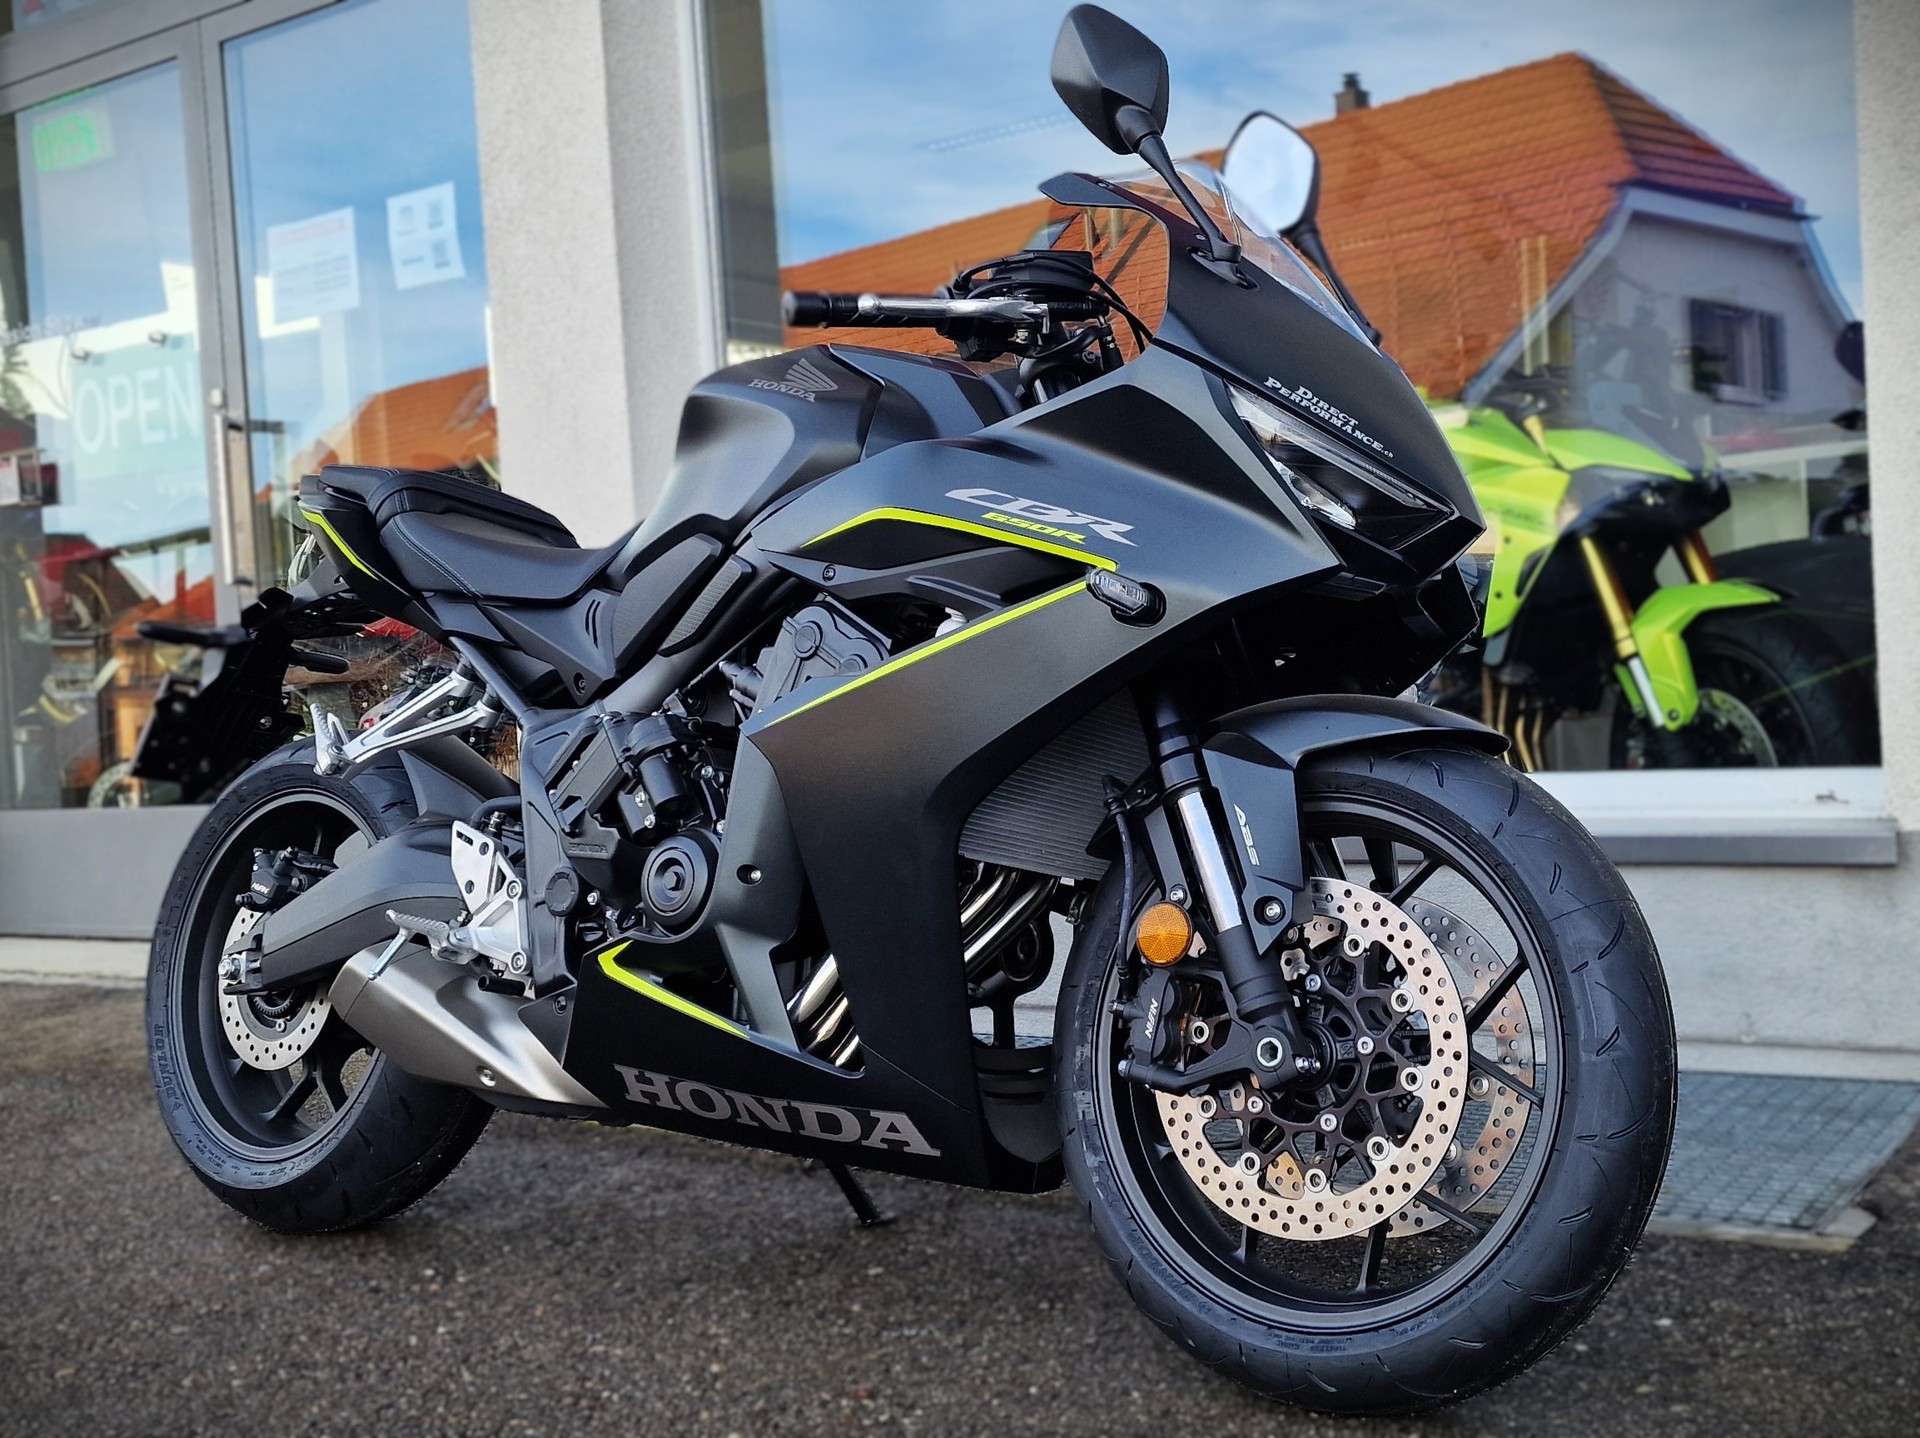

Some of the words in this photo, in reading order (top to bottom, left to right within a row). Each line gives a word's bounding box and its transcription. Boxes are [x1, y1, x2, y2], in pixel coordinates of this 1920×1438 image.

[73, 362, 202, 454] OPEN
[748, 379, 816, 402] HONDA
[1295, 385, 1358, 426] DIRECT
[944, 488, 1140, 548] CBR
[981, 511, 1087, 545] 650R
[1233, 803, 1260, 867] ABS
[154, 1023, 181, 1099] DUNLOP
[613, 1063, 941, 1157] HONDA
